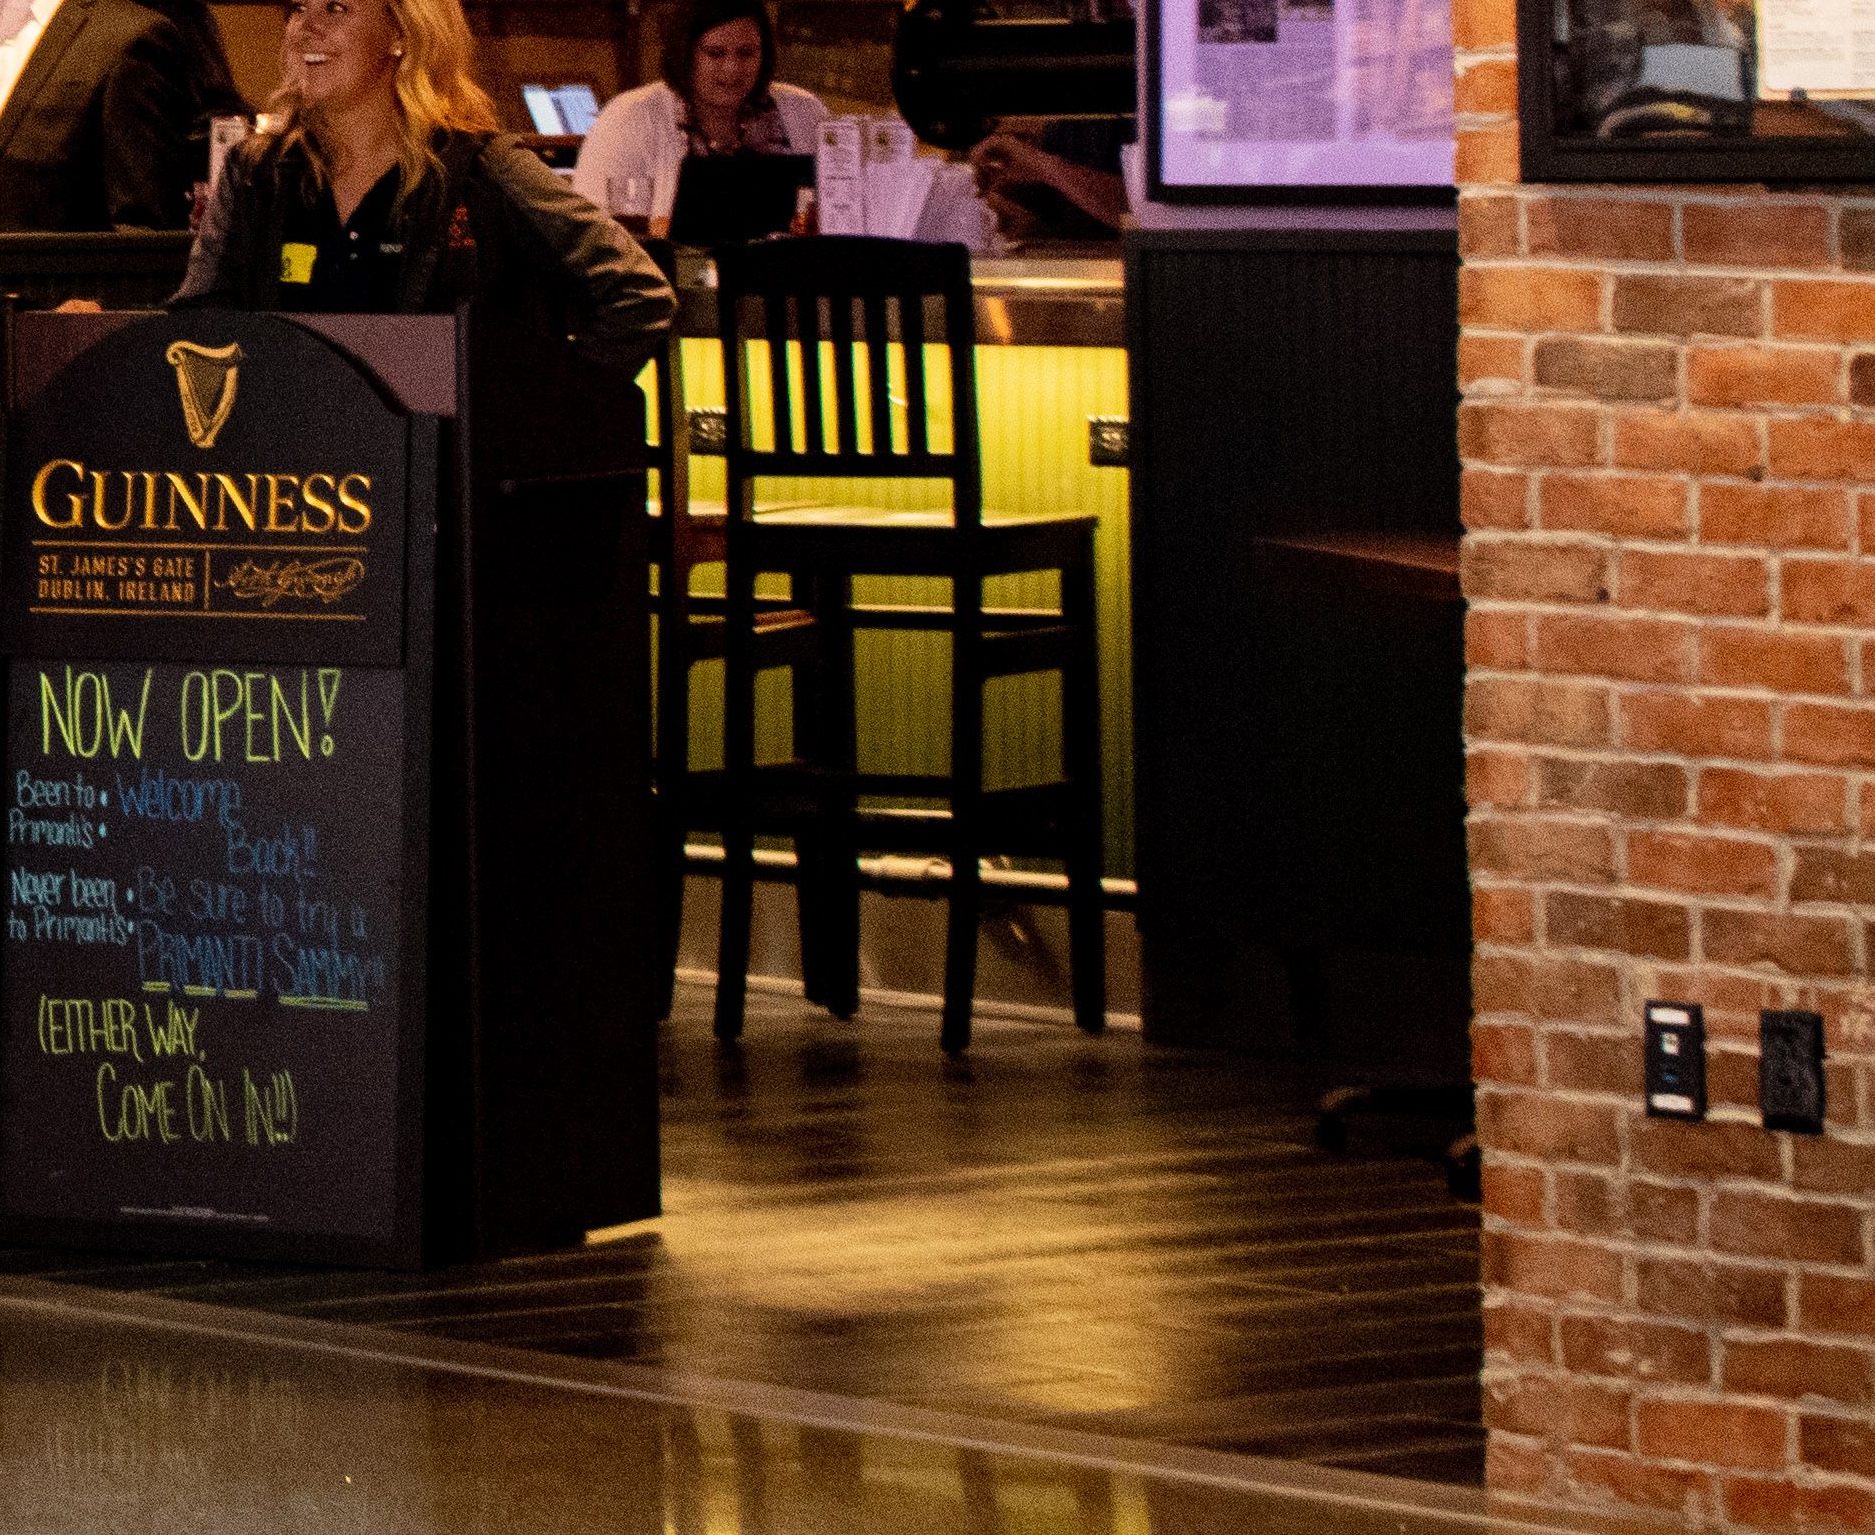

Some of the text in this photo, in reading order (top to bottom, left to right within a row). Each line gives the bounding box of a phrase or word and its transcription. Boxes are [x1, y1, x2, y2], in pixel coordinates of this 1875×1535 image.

[31, 459, 372, 534] GUINNESS
[70, 555, 145, 577] JAMES'S
[152, 556, 195, 578] GATE
[119, 580, 196, 603] IRELAND
[39, 664, 342, 763] NOW OPEN!
[16, 769, 70, 807] Been
[10, 865, 117, 913] Never been
[38, 993, 144, 1063] (EITHER
[97, 1062, 181, 1145] COME
[186, 1064, 230, 1142] ON
